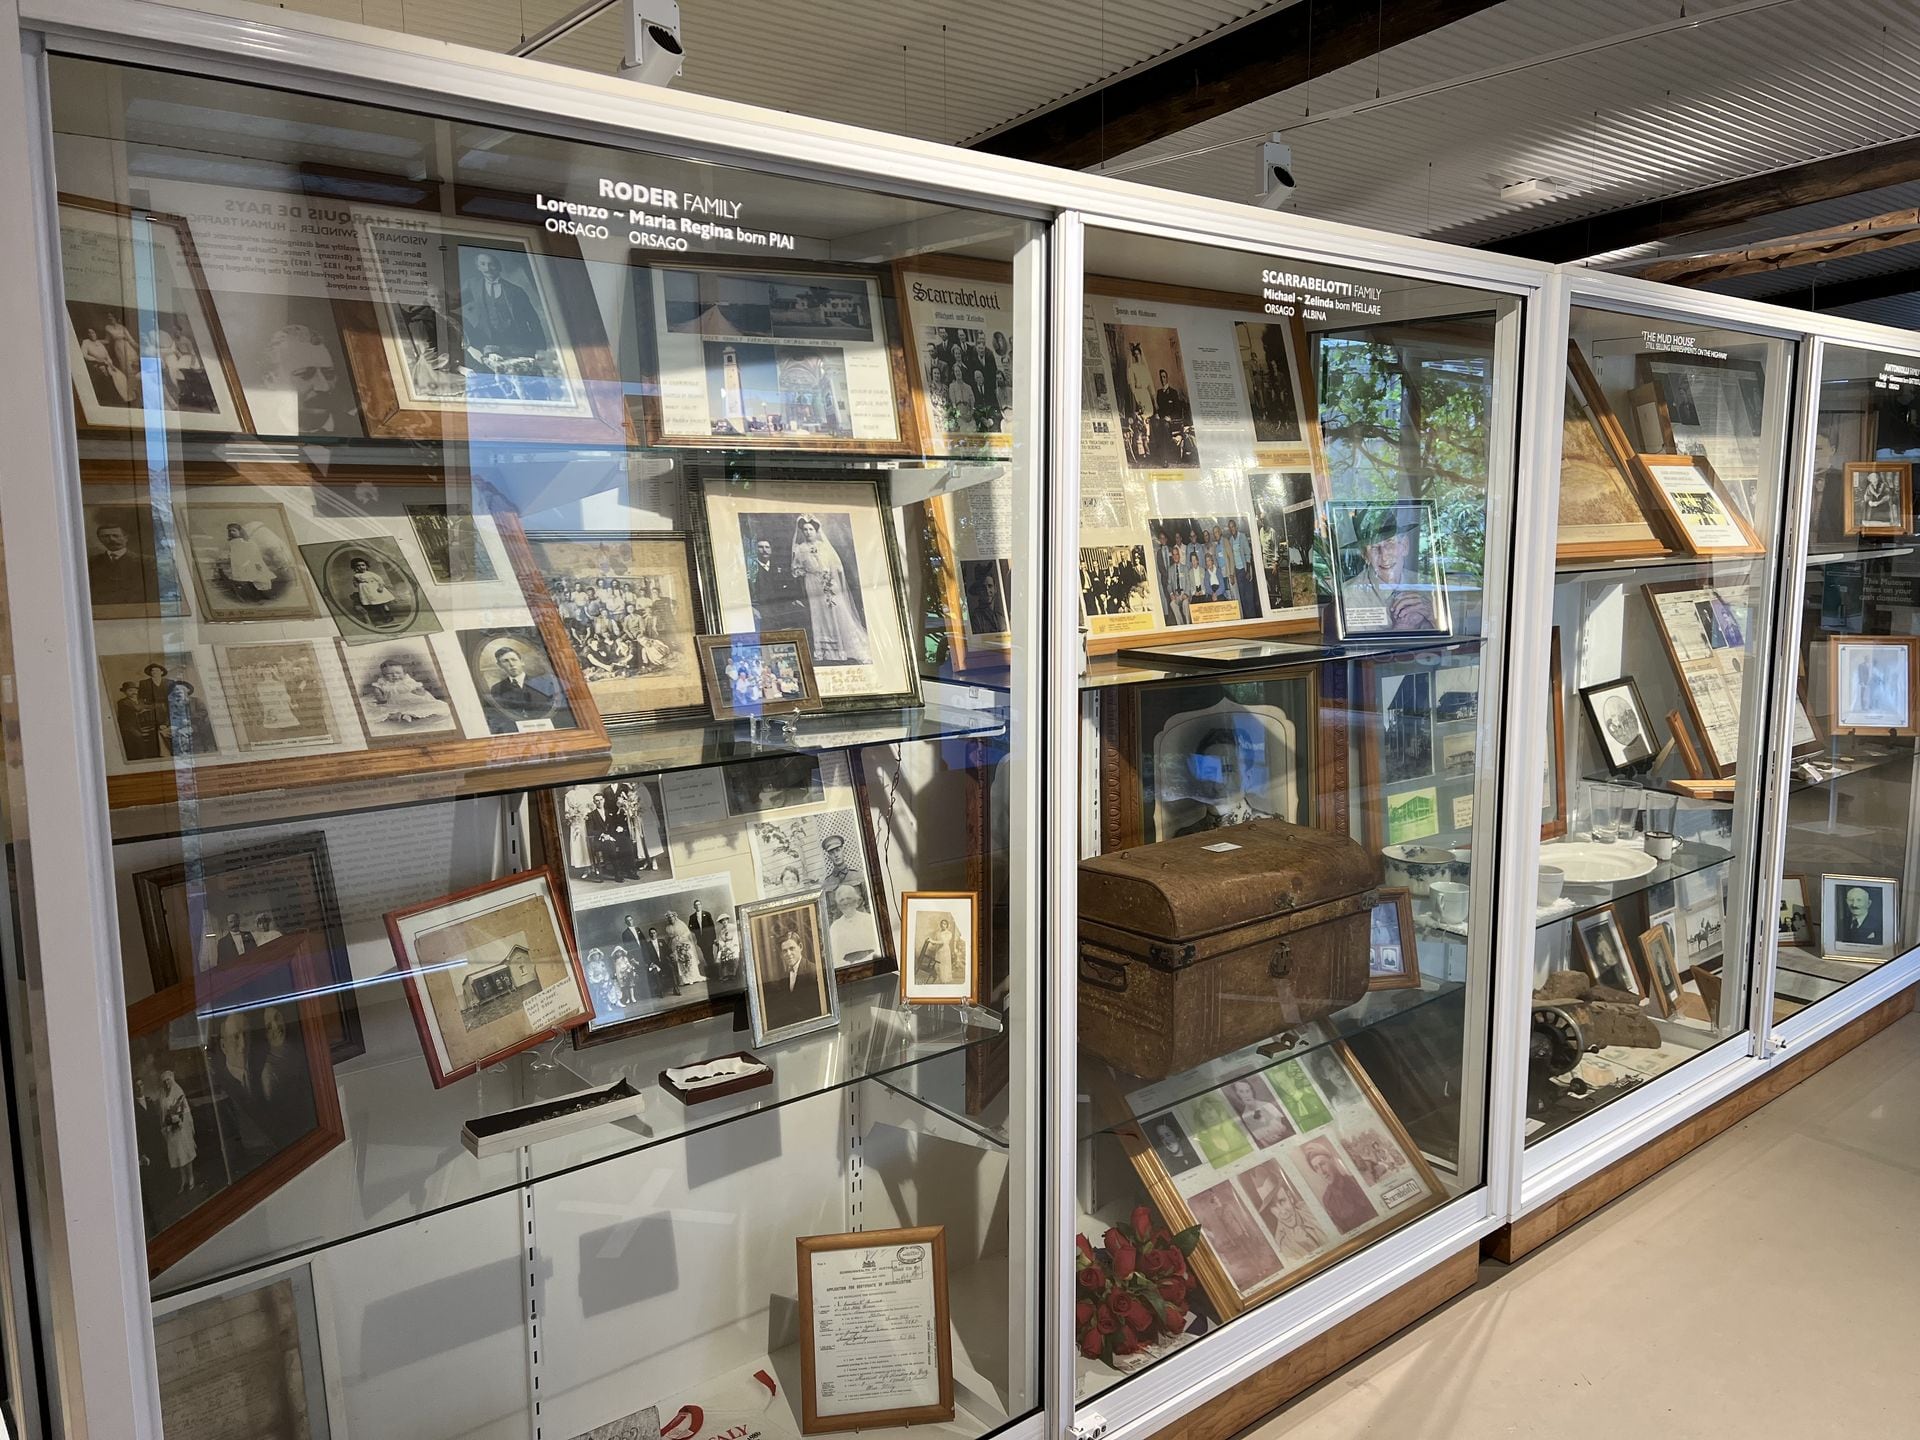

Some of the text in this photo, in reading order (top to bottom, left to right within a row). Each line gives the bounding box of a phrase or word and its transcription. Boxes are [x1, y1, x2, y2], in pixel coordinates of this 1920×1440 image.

[599, 179, 743, 219] RODER FAMILY
[536, 194, 608, 220] Lorenzo
[629, 209, 677, 231] Maria
[681, 217, 734, 241] Regina
[737, 227, 767, 246] born
[769, 233, 795, 250] PIAI
[545, 218, 688, 252] ORSAGO ORSAGO
[912, 282, 1000, 310] Scarrabelotti
[1262, 269, 1383, 301] SCARRABELOTTI FAMILY
[1263, 288, 1296, 303] Michael
[1304, 294, 1334, 308] Zelinda
[1335, 301, 1351, 311] born
[1351, 302, 1382, 316] MELLARE
[1264, 303, 1327, 321] ORSAGO ALBINA
[1657, 333, 1672, 344] MUD
[1863, 576, 1912, 586] This Museum
[1894, 588, 1913, 596] your
